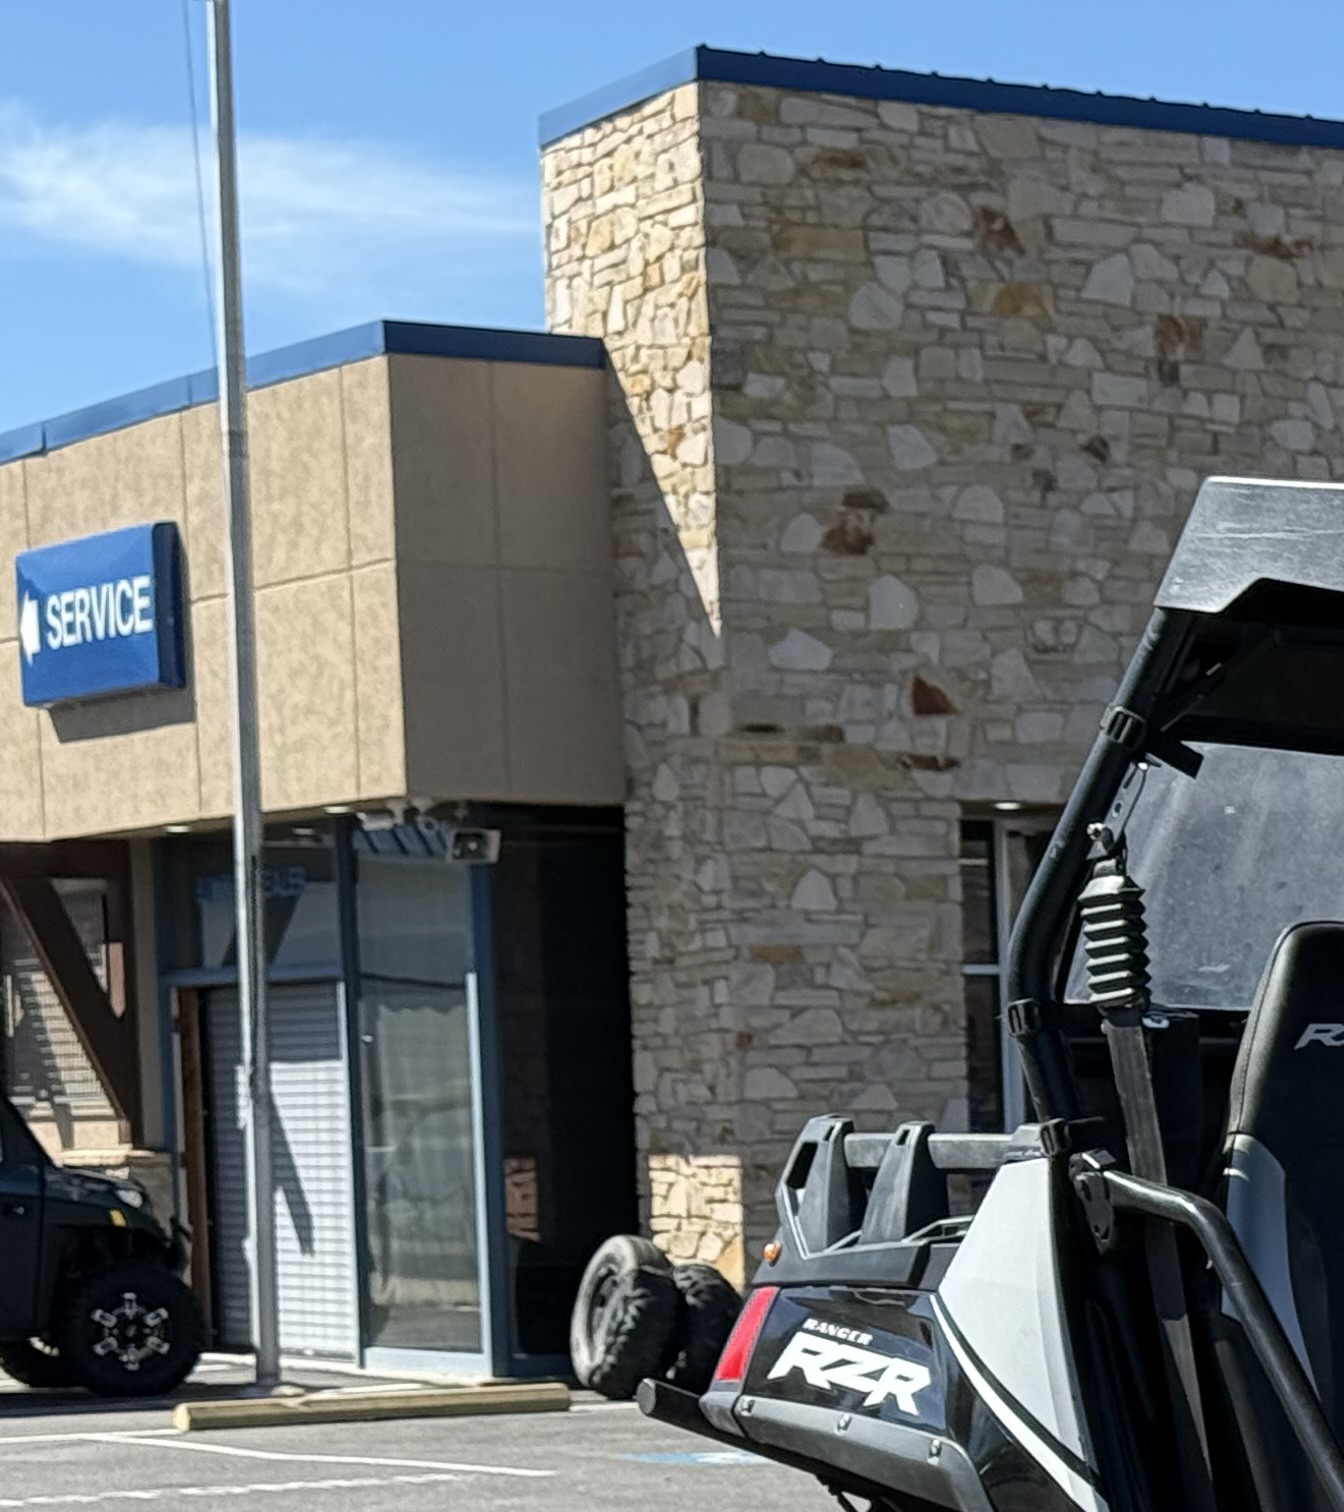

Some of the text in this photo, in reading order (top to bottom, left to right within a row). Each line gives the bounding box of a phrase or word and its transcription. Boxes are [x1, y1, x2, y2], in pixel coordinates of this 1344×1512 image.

[46, 574, 153, 650] SERVICE
[802, 1318, 873, 1346] RANGER
[767, 1331, 931, 1416] RZR
